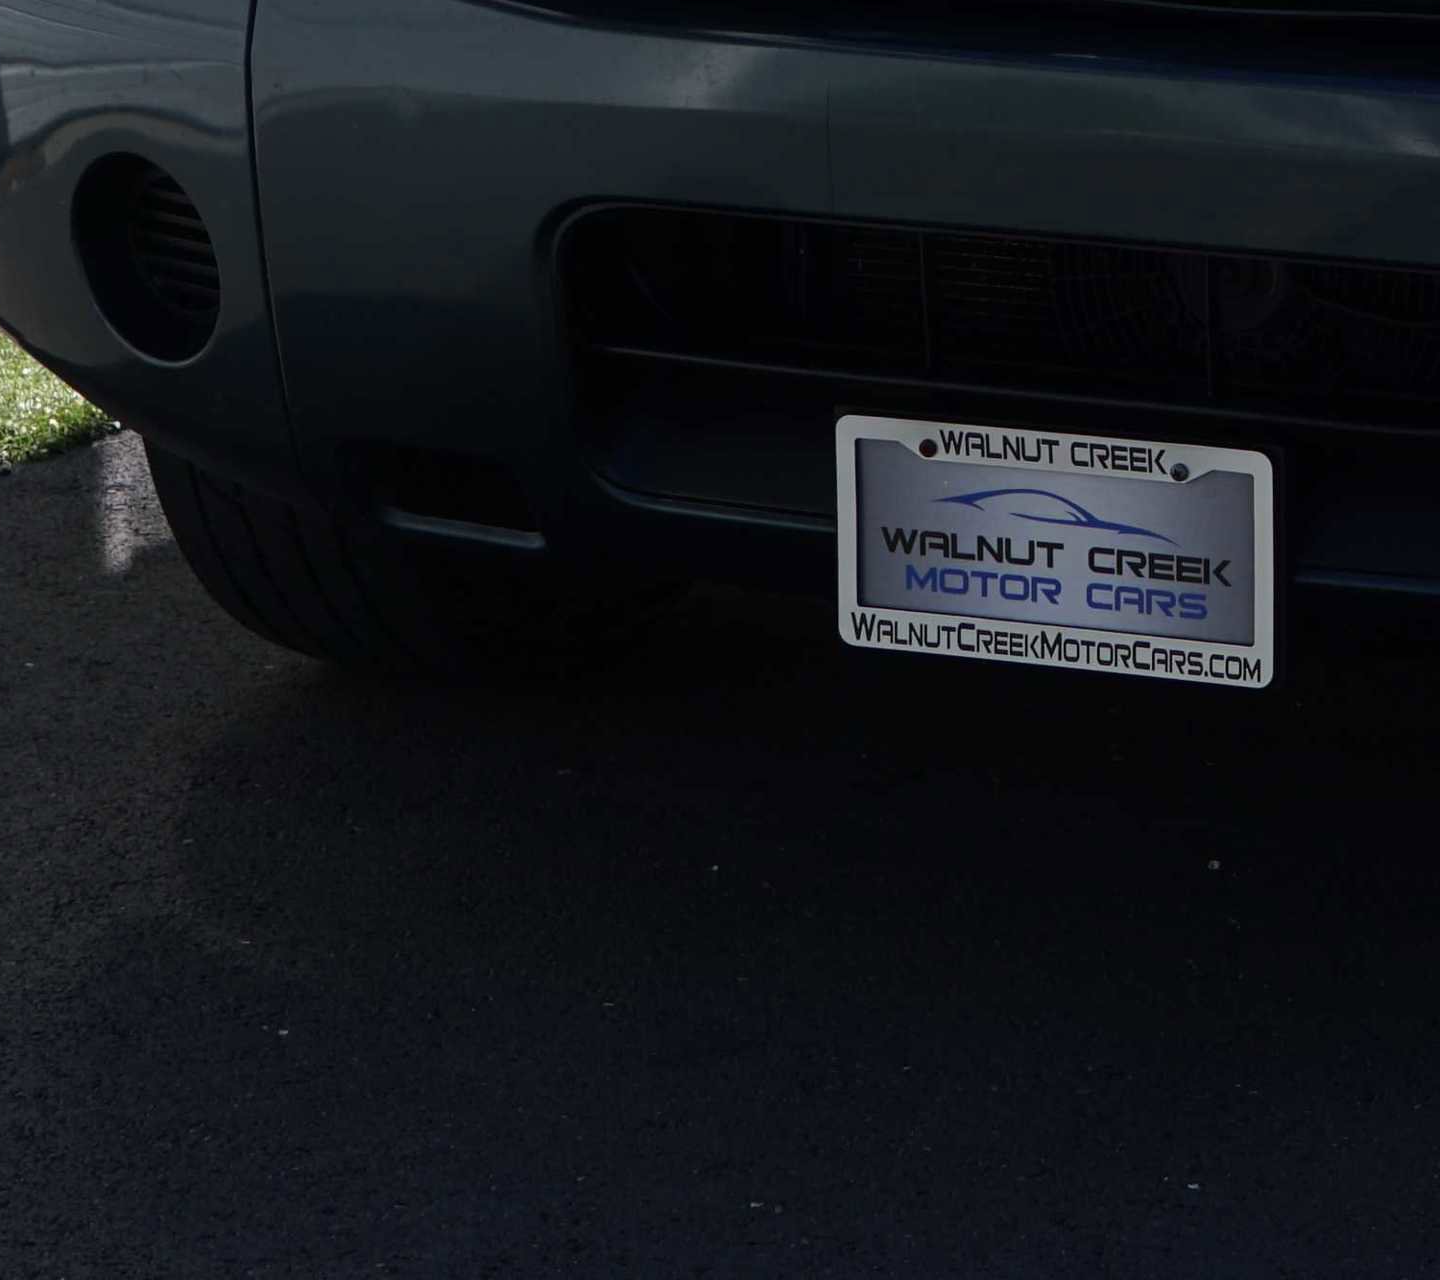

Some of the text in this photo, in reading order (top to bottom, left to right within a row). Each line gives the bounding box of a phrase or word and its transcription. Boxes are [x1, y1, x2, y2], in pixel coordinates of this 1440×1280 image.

[939, 428, 1169, 475] WALNUT CREEK
[880, 526, 1232, 588] WALNUT CREEK
[904, 564, 1208, 621] MOTOR CARS
